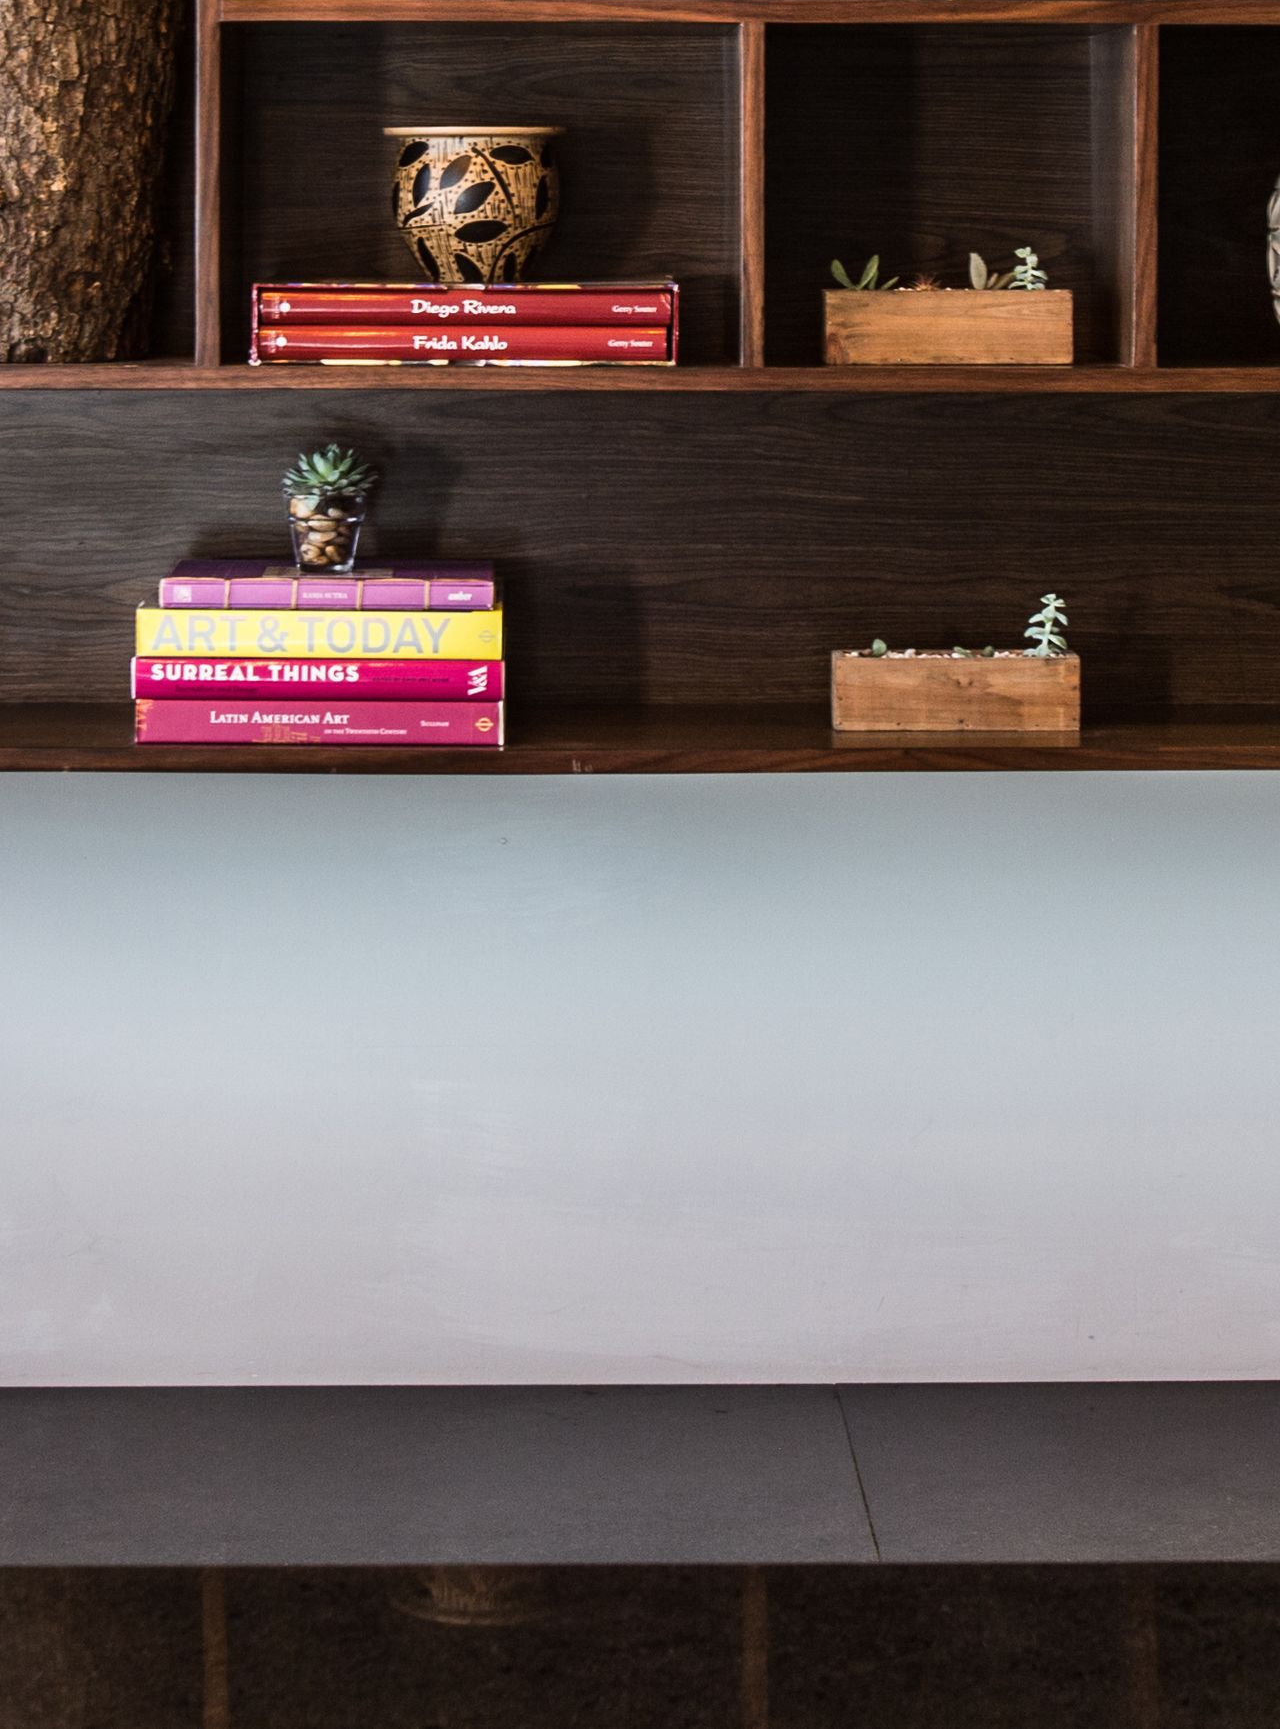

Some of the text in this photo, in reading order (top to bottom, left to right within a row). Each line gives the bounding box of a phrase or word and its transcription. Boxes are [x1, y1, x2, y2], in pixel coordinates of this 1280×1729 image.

[410, 299, 517, 318] Diego Rivera
[412, 335, 508, 351] Frida Kahlo
[152, 615, 451, 654] ART & TODAY
[150, 664, 360, 683] SURREAL THINGS
[210, 711, 350, 725] LATIN AMERICAN ART
